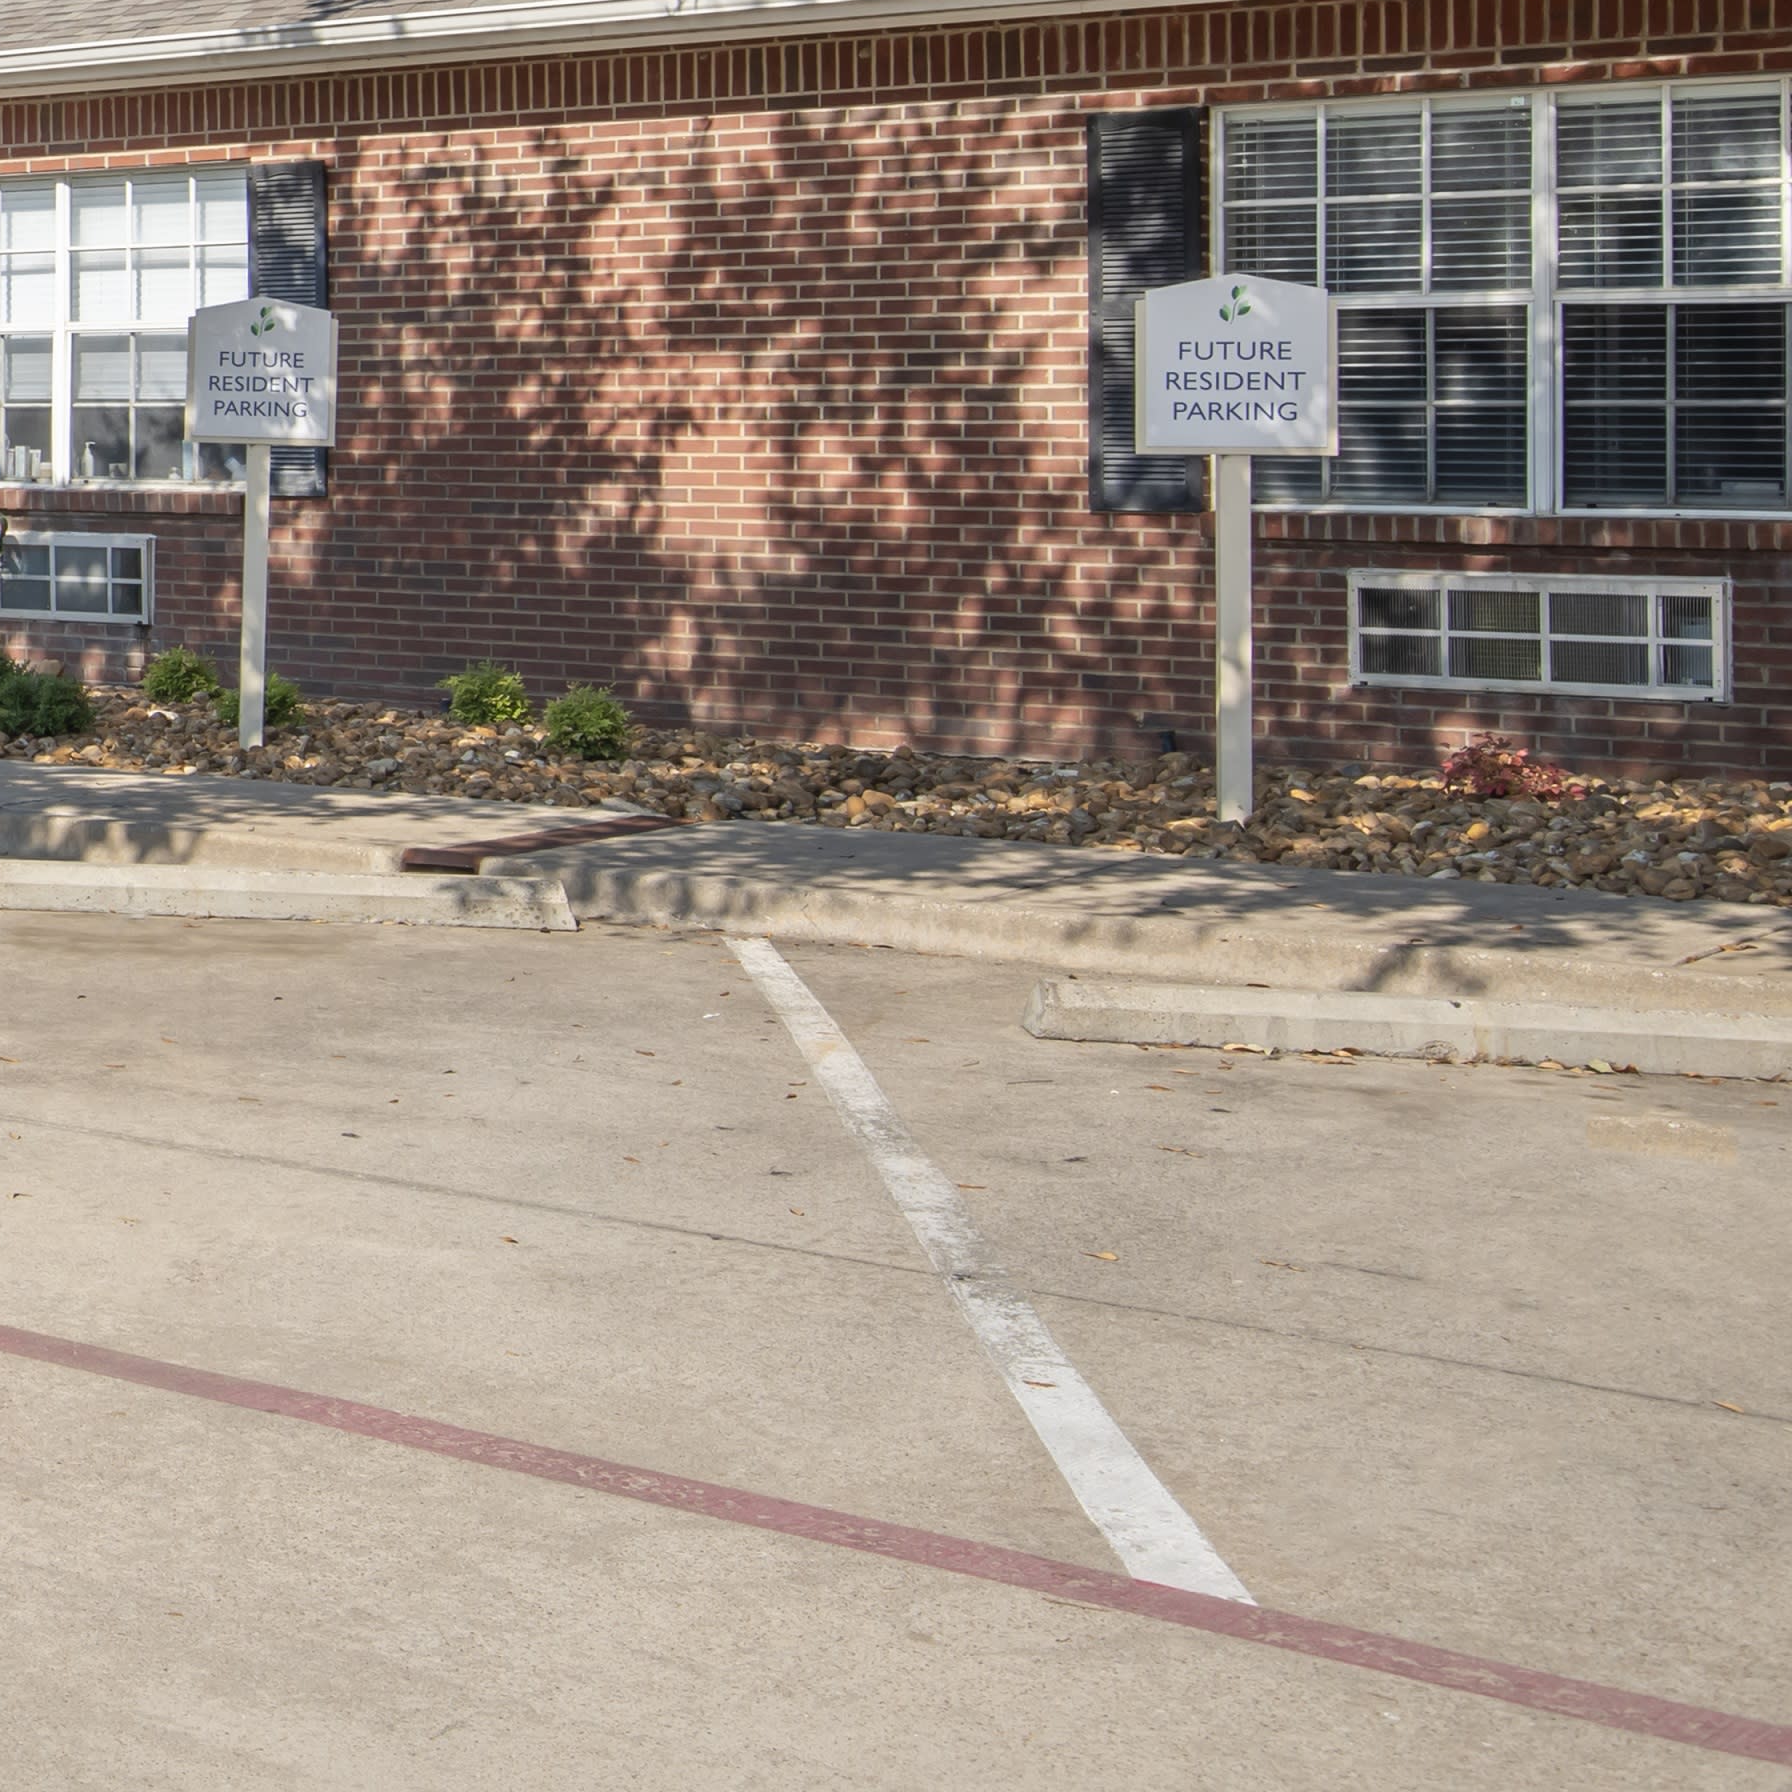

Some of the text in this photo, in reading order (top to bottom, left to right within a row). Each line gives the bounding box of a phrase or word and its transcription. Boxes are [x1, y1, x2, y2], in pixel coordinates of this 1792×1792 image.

[219, 351, 305, 369] FUTURE
[1178, 340, 1293, 361] FUTURE
[208, 375, 315, 393] RESIDENT
[1165, 371, 1308, 391] RESIDENT
[213, 399, 308, 418] PARKING
[1172, 401, 1298, 422] PARKING
